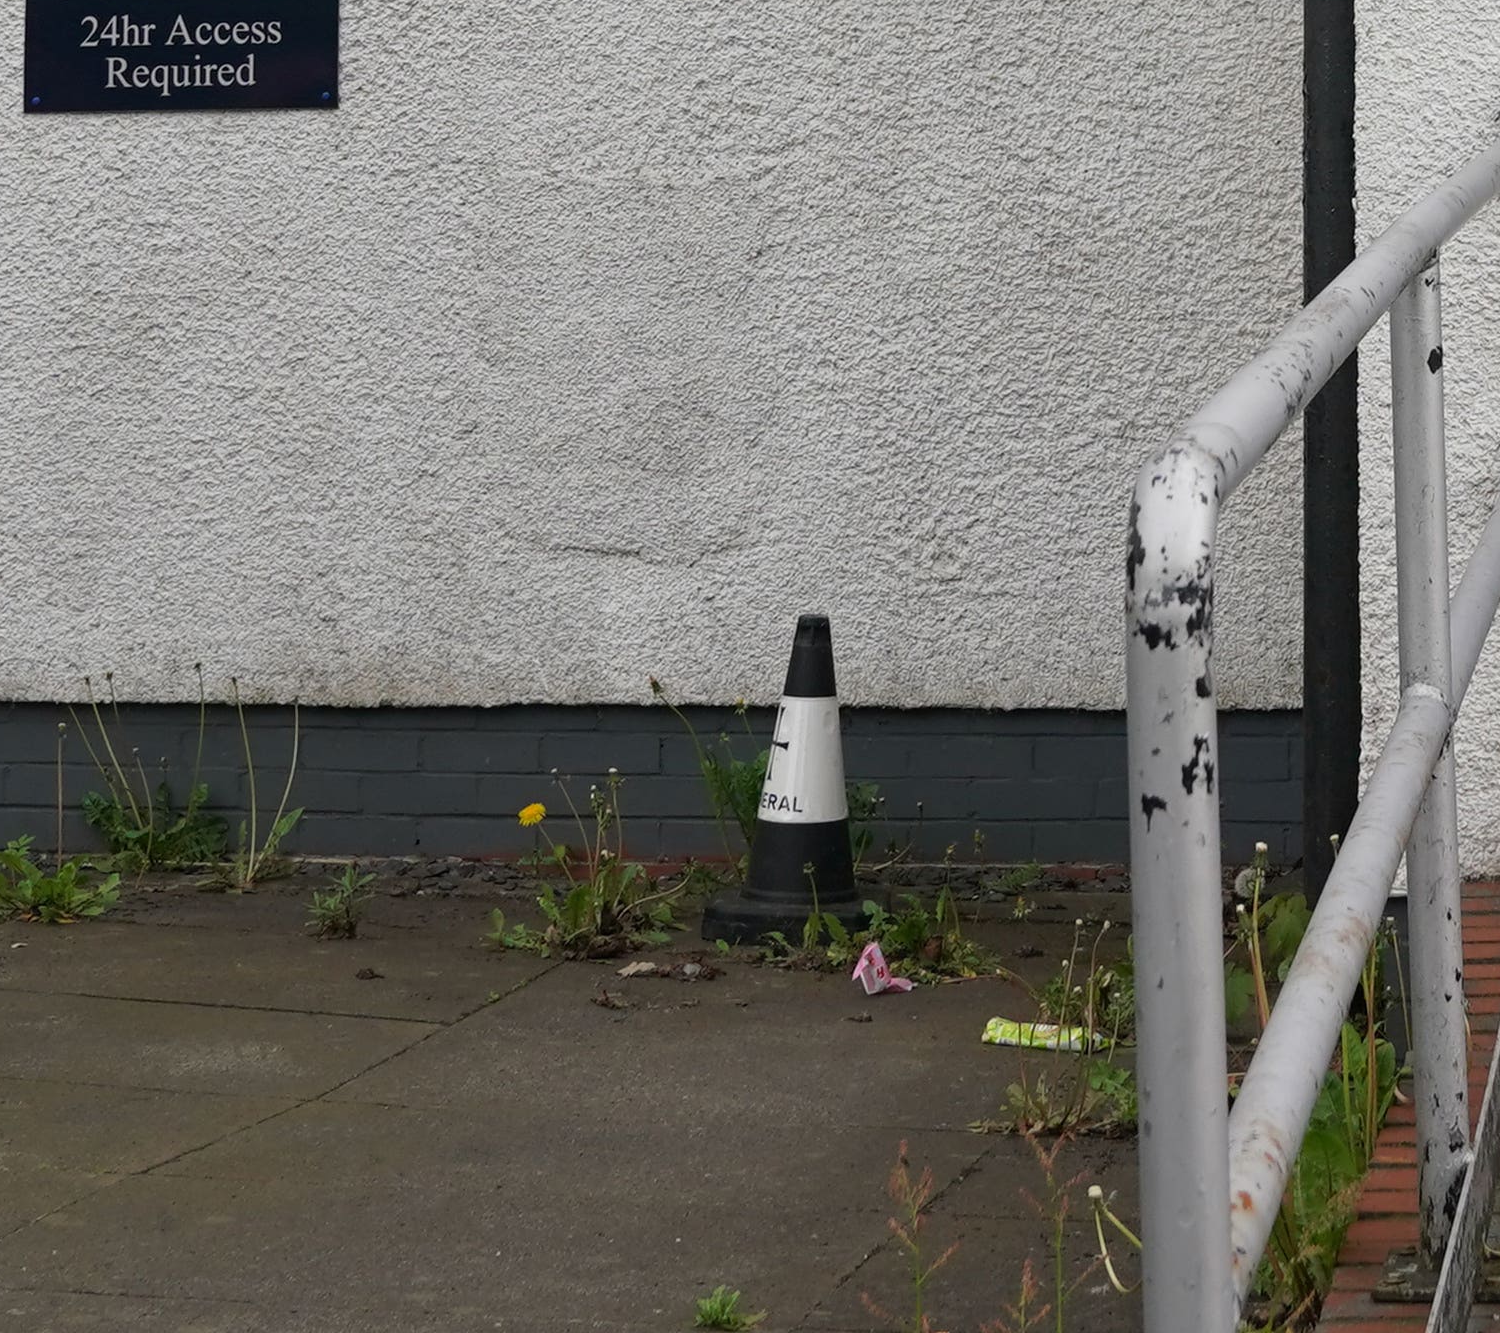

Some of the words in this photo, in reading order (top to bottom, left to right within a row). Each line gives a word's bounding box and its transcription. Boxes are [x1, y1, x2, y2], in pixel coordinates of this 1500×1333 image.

[80, 15, 156, 46] 24hr
[165, 15, 281, 45] Access
[106, 54, 255, 96] Required
